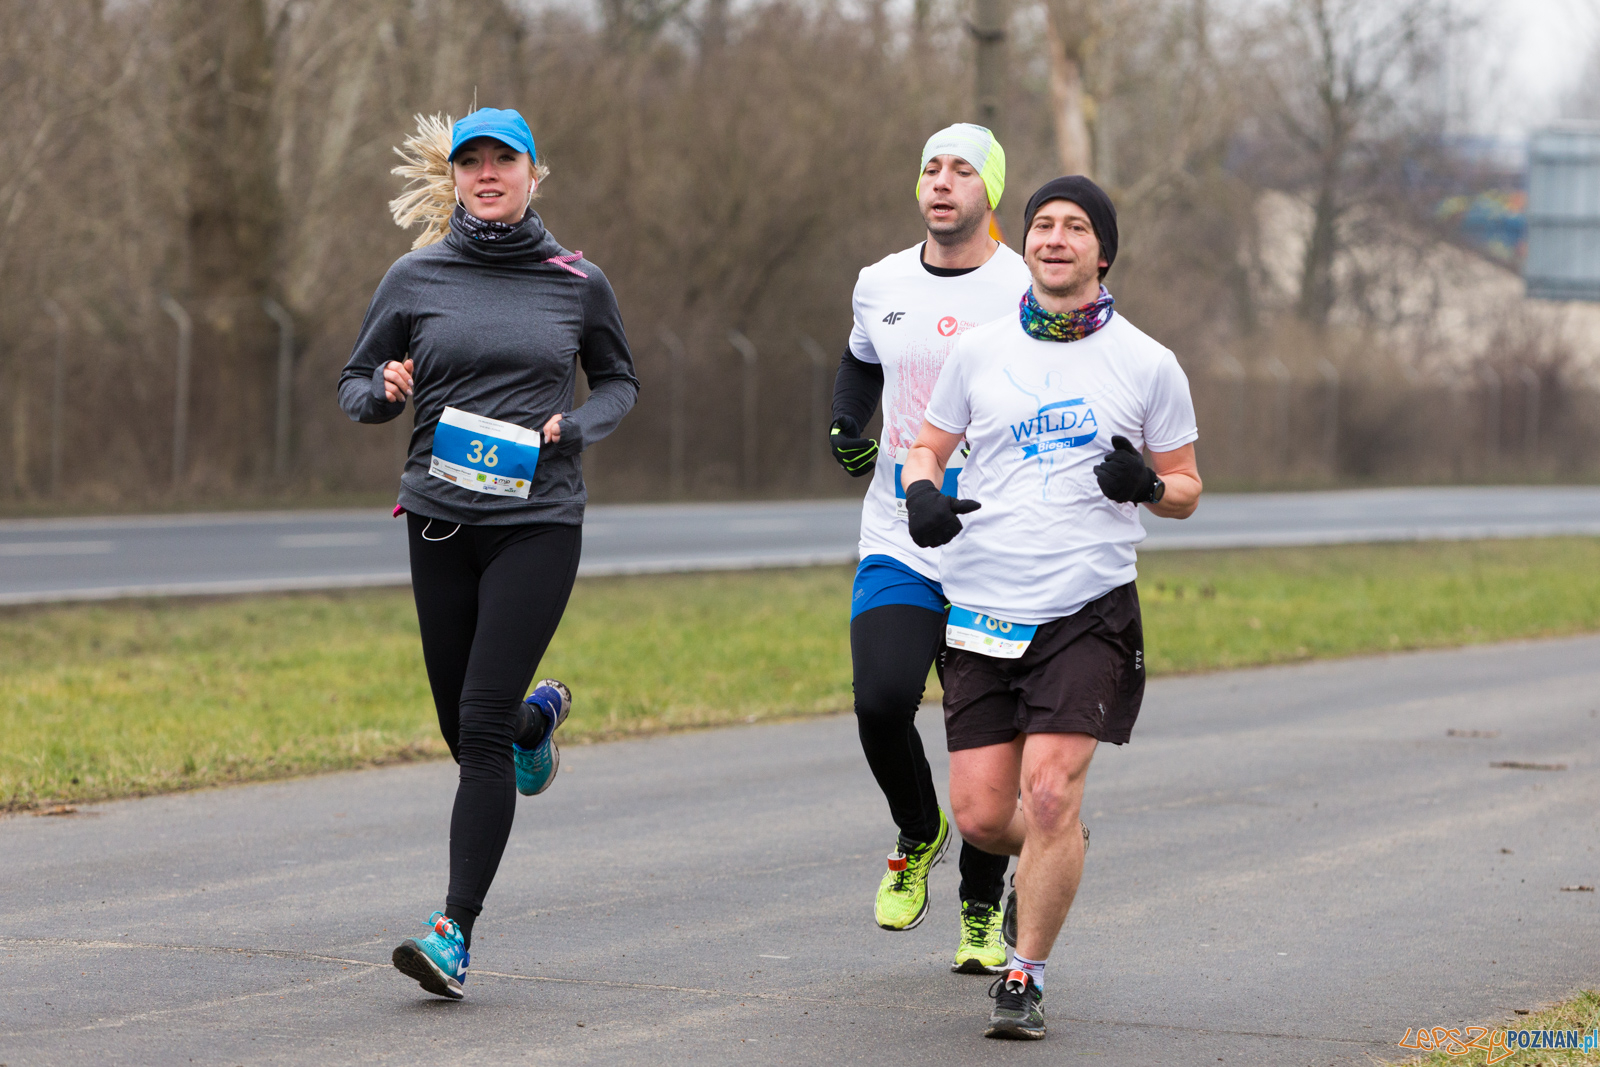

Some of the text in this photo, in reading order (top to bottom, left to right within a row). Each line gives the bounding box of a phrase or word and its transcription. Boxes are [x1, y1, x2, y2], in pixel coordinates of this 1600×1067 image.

[882, 311, 906, 325] 4F
[1010, 408, 1098, 442] WILDA
[466, 439, 499, 468] 36
[1037, 437, 1075, 453] Biega!
